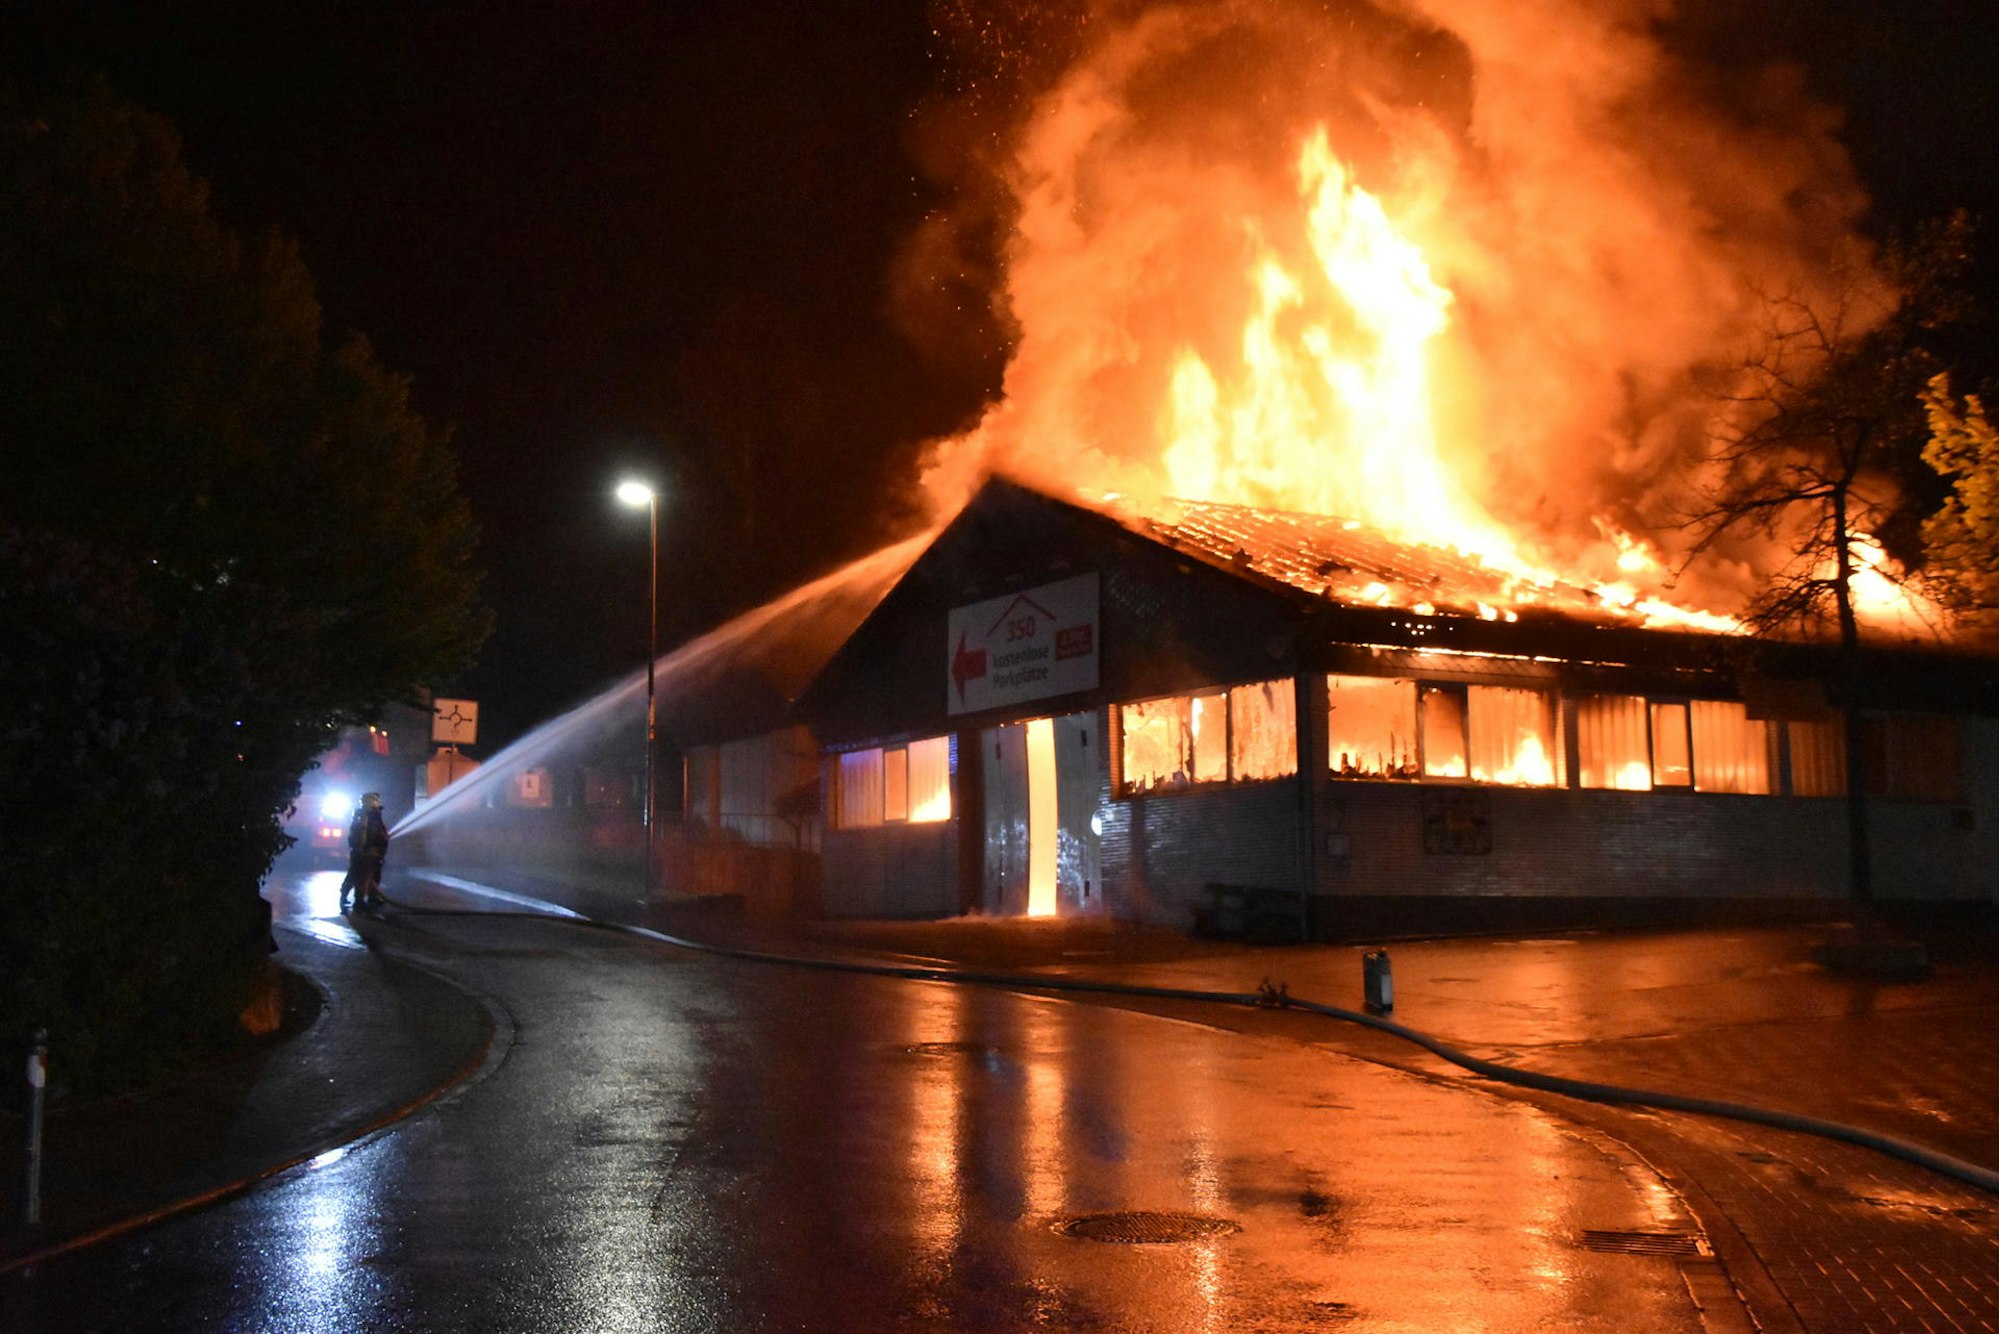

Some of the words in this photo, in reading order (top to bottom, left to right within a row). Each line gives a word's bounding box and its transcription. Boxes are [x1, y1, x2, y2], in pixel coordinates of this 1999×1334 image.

[1007, 616, 1035, 642] 350
[993, 646, 1048, 667] kostenlose
[993, 667, 1048, 688] Parkplätze
